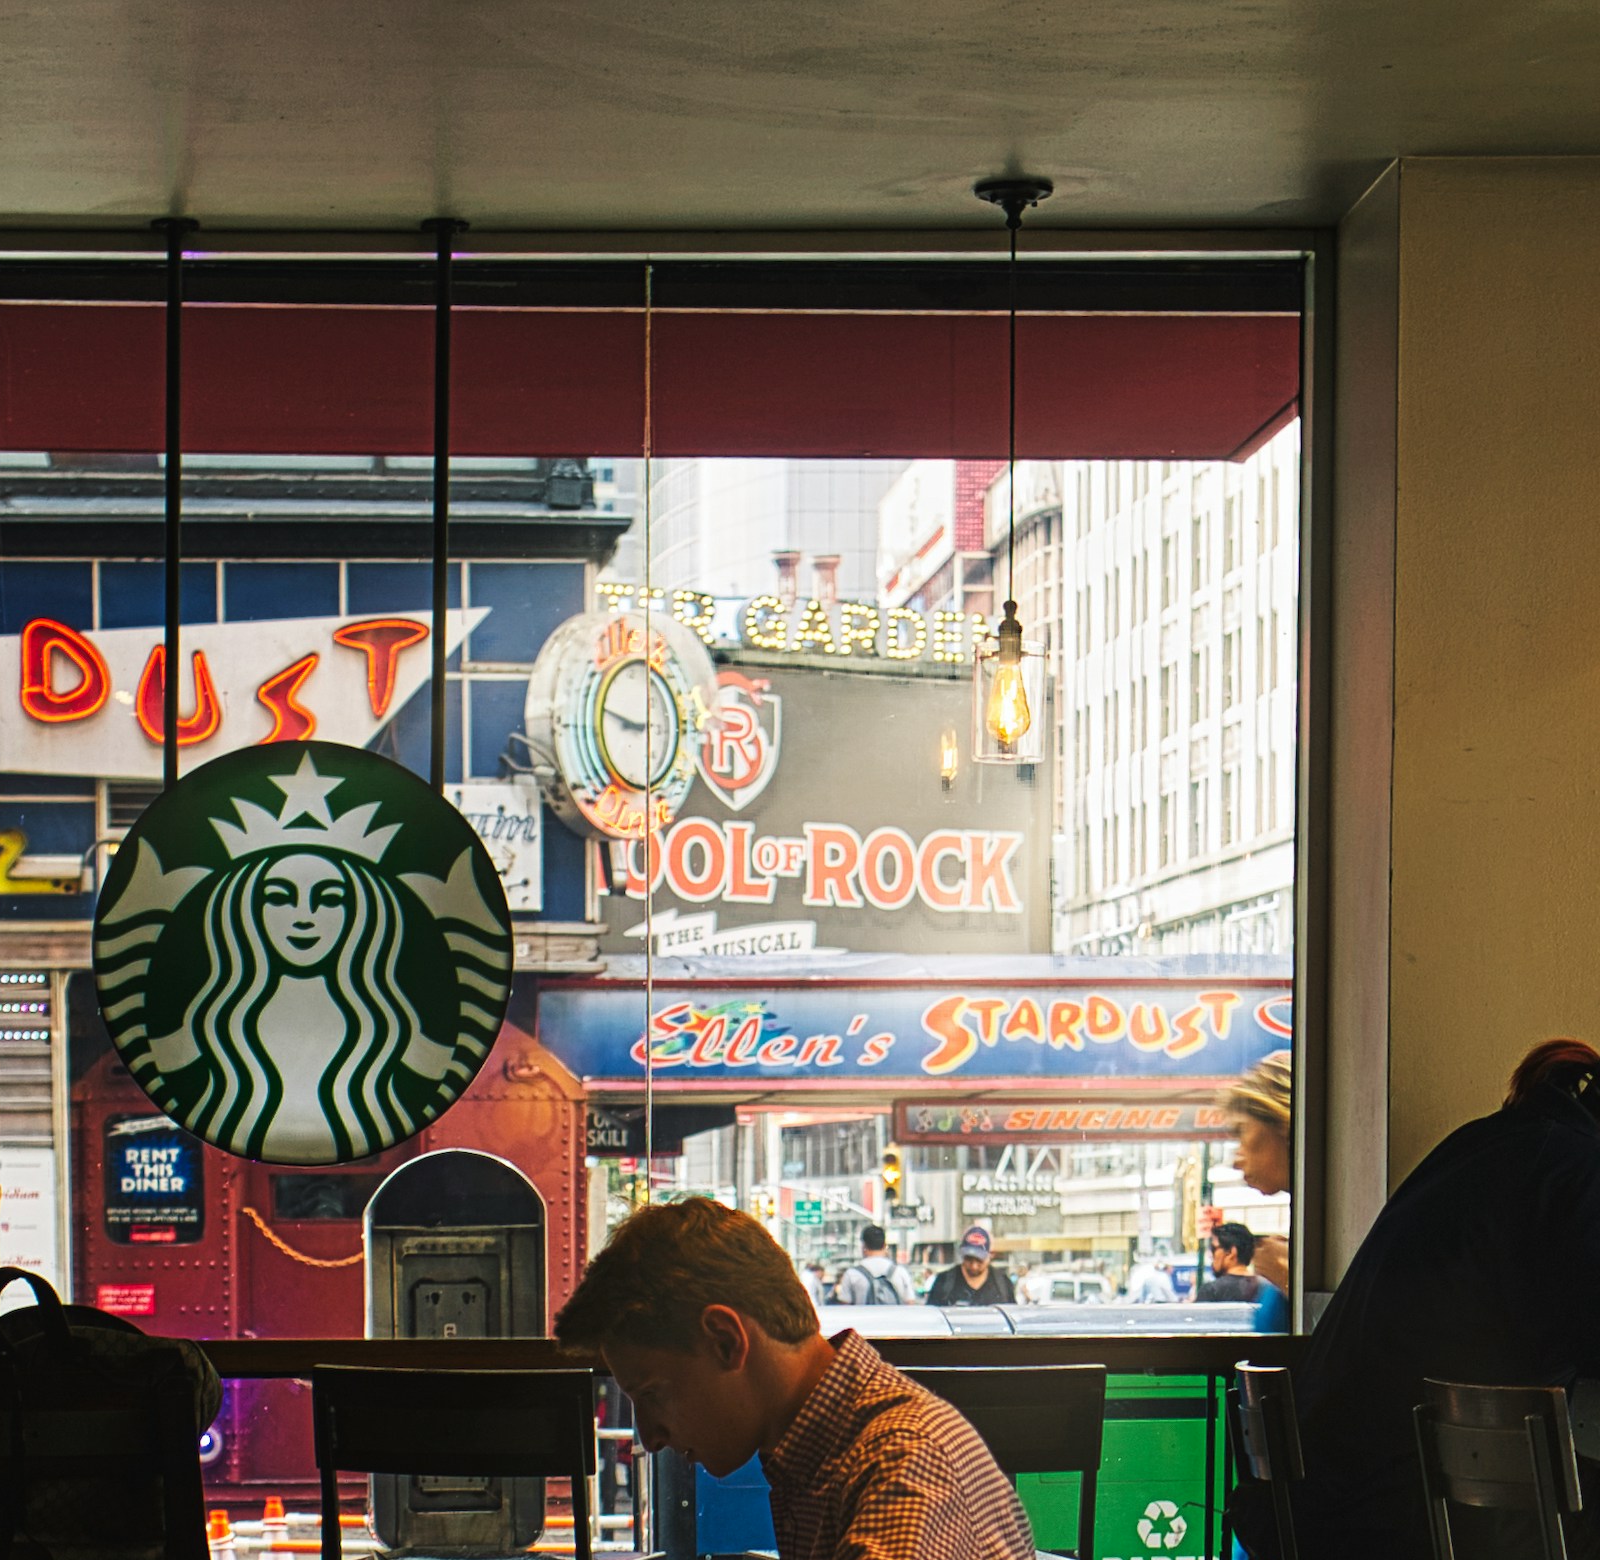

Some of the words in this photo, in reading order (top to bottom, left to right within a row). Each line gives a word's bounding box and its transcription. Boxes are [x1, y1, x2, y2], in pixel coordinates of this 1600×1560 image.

[752, 836, 806, 877] OF
[803, 822, 1024, 914] ROCK
[663, 926, 704, 947] THE
[631, 1002, 896, 1069] Ellen's
[921, 990, 1241, 1075] STARDUST
[1004, 1108, 1181, 1130] SINGING
[125, 1147, 180, 1164] RENT
[131, 1164, 174, 1178] THIS
[121, 1177, 185, 1192] DINER
[1, 1188, 40, 1201] ridium
